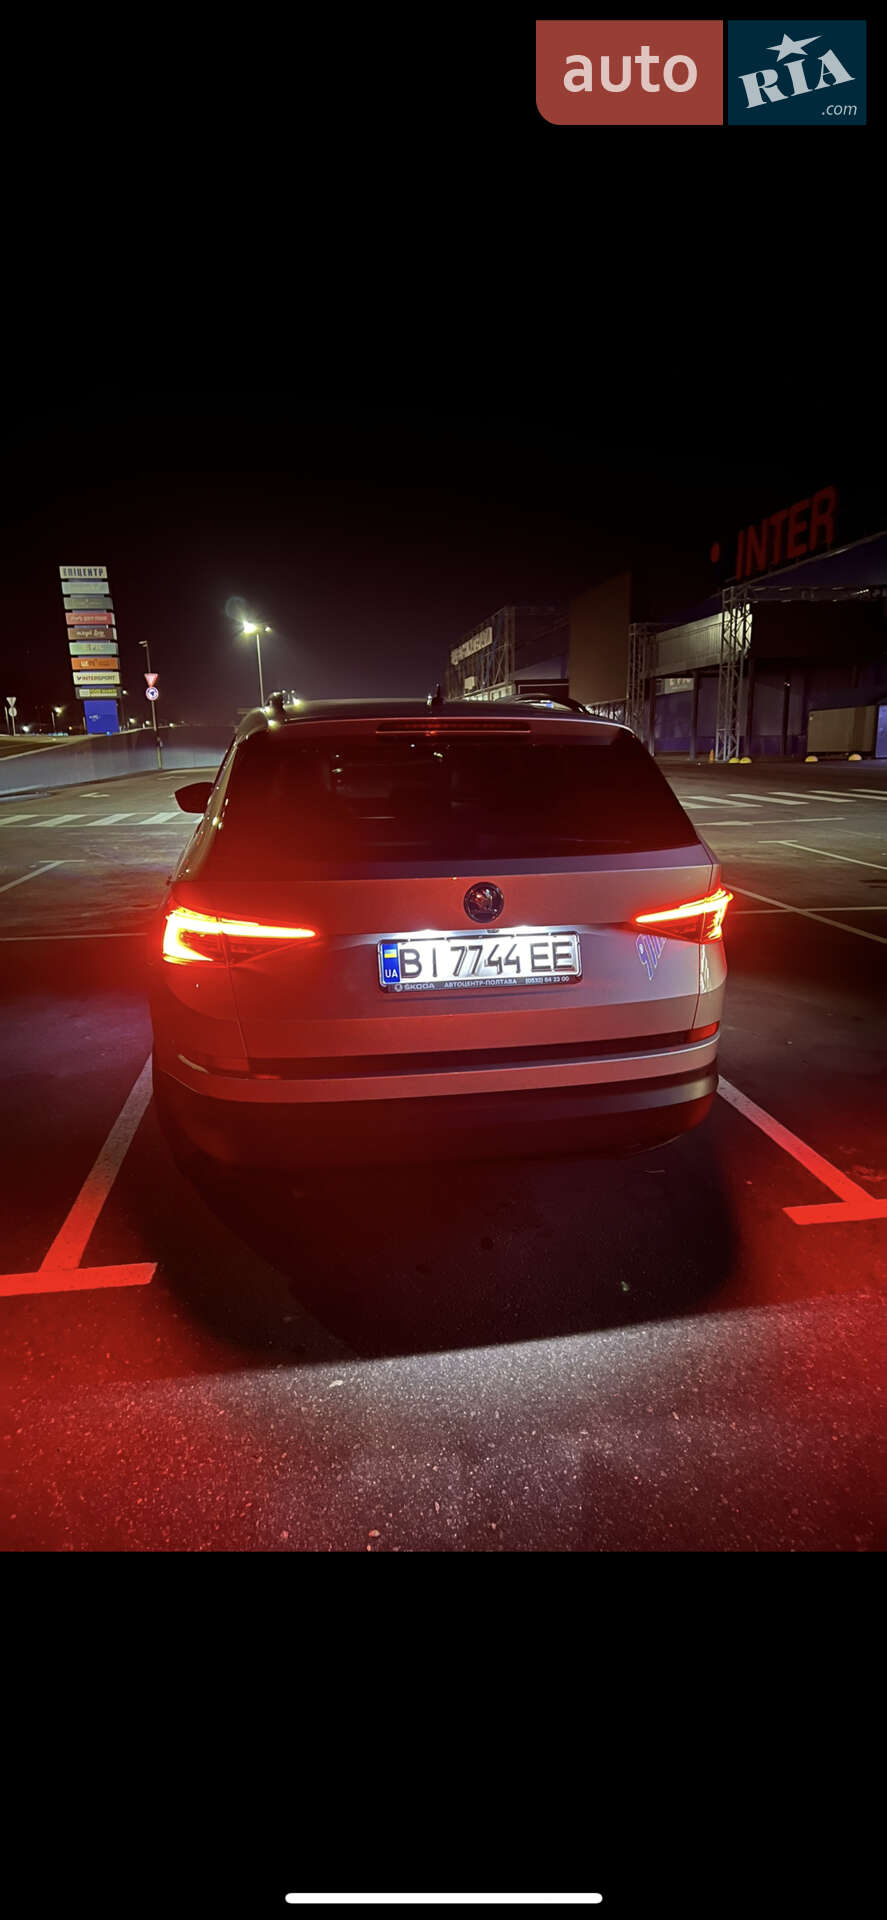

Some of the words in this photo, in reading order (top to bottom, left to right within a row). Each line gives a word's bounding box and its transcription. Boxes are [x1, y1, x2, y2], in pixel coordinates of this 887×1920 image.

[735, 484, 838, 582] INTER
[450, 943, 521, 977] 7744
[530, 941, 573, 973] EE
[384, 969, 398, 979] UA
[444, 978, 518, 988] АВТОЦЕНТР-ПОЛТАВА
